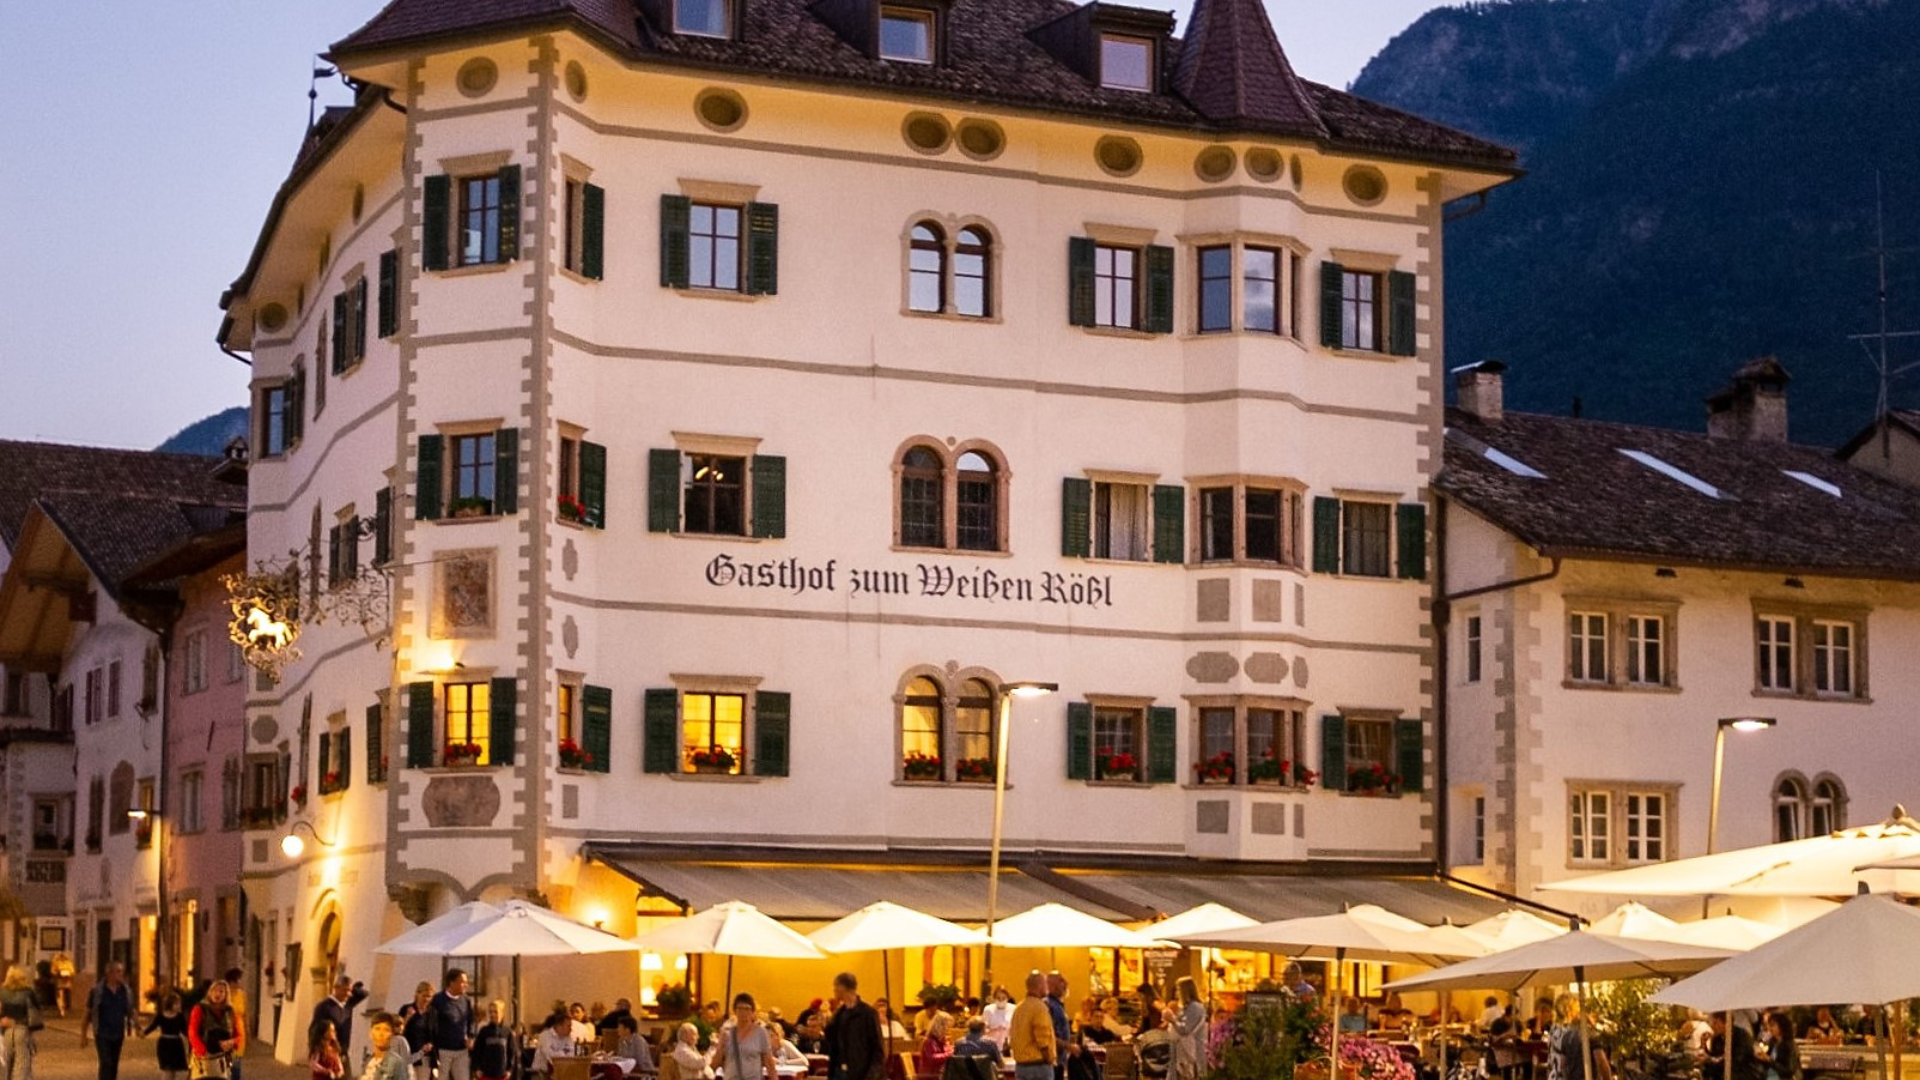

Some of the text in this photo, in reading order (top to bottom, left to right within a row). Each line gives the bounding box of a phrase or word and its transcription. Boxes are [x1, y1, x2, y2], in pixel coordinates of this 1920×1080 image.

[705, 553, 1112, 609] Gasthof zum Weißen Rößl
